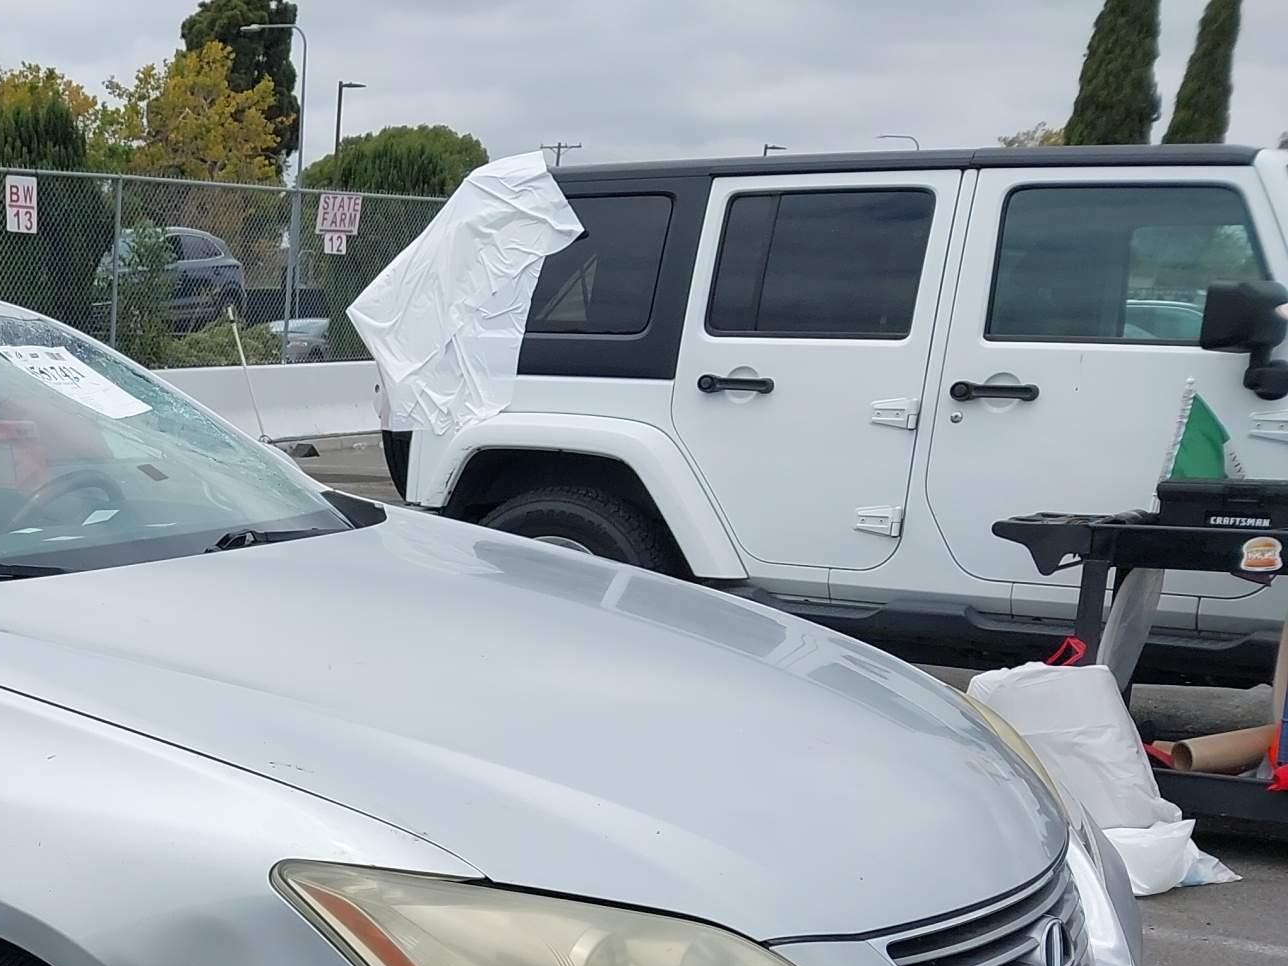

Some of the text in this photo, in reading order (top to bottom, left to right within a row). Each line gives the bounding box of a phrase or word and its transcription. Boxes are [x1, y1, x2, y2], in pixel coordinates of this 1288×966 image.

[9, 184, 34, 205] BW
[322, 195, 361, 213] STATE
[13, 209, 34, 231] 13
[321, 211, 358, 229] FARM
[327, 234, 344, 253] 12
[1209, 516, 1271, 528] CRAFTSMAN
